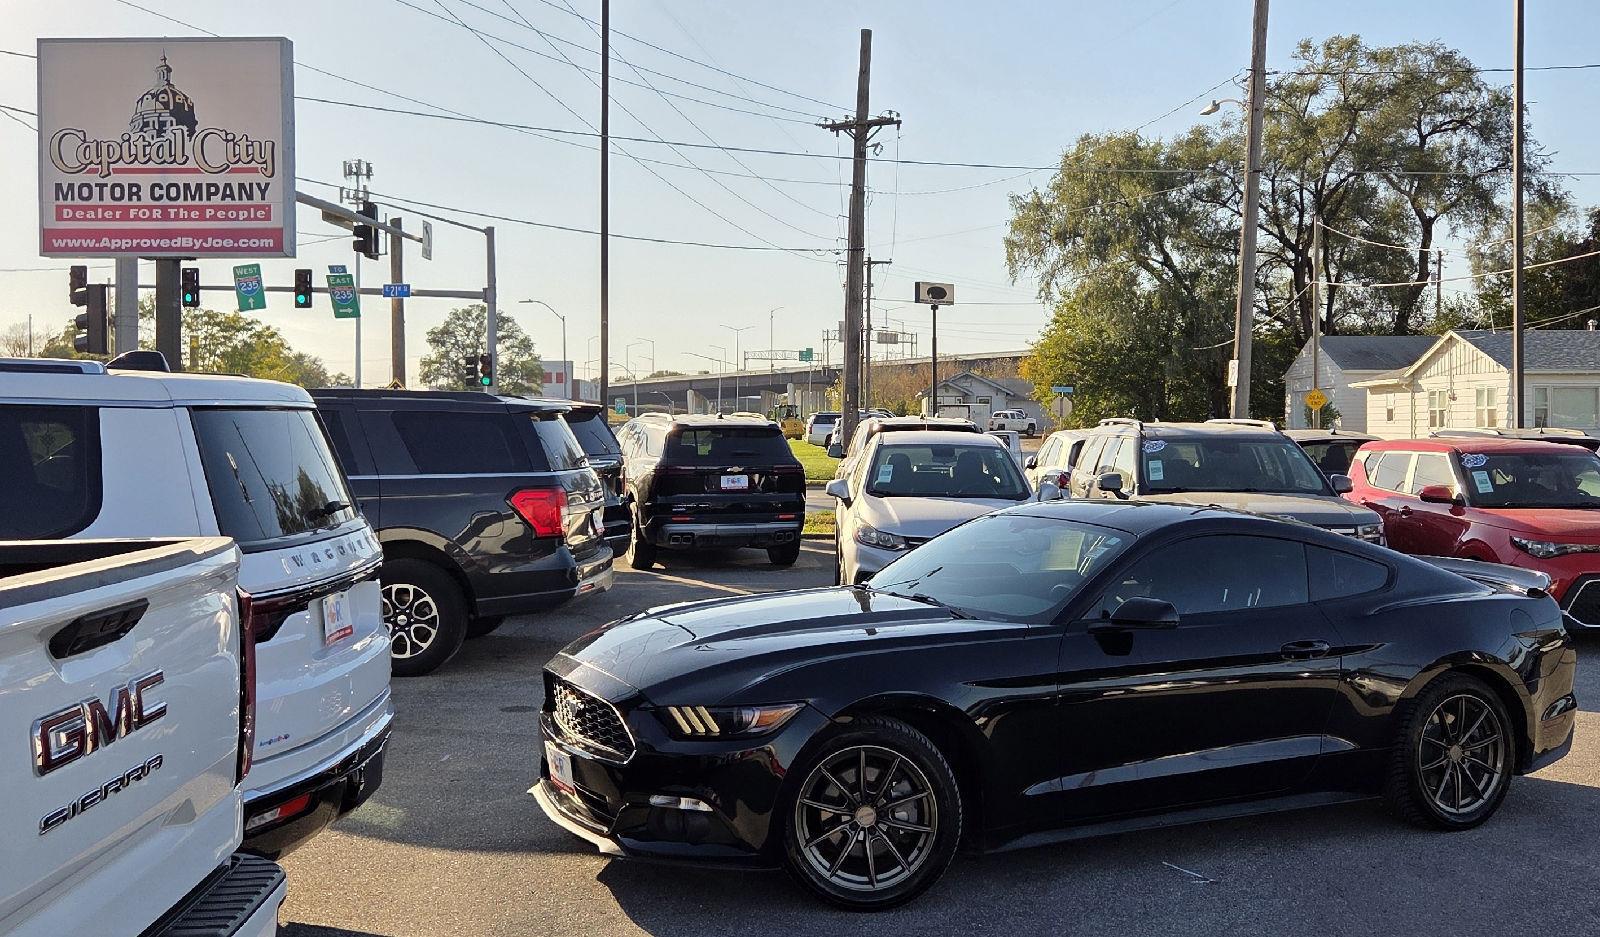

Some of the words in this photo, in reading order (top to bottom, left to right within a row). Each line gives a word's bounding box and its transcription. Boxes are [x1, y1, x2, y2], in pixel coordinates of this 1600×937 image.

[50, 128, 189, 178] Capital
[193, 128, 276, 178] City
[54, 183, 142, 202] MOTOR
[149, 182, 271, 202] COMPANY
[62, 208, 123, 219] Dealer
[129, 208, 162, 219] FOR
[168, 208, 200, 219] The
[205, 207, 267, 221] People
[52, 236, 274, 250] www.ApprovedByJoe.com
[235, 267, 258, 276] WEST
[240, 280, 259, 292] 235
[329, 277, 351, 285] EAST
[334, 290, 353, 300] 235
[30, 668, 168, 778] GMC
[38, 753, 164, 836] SIERRA
